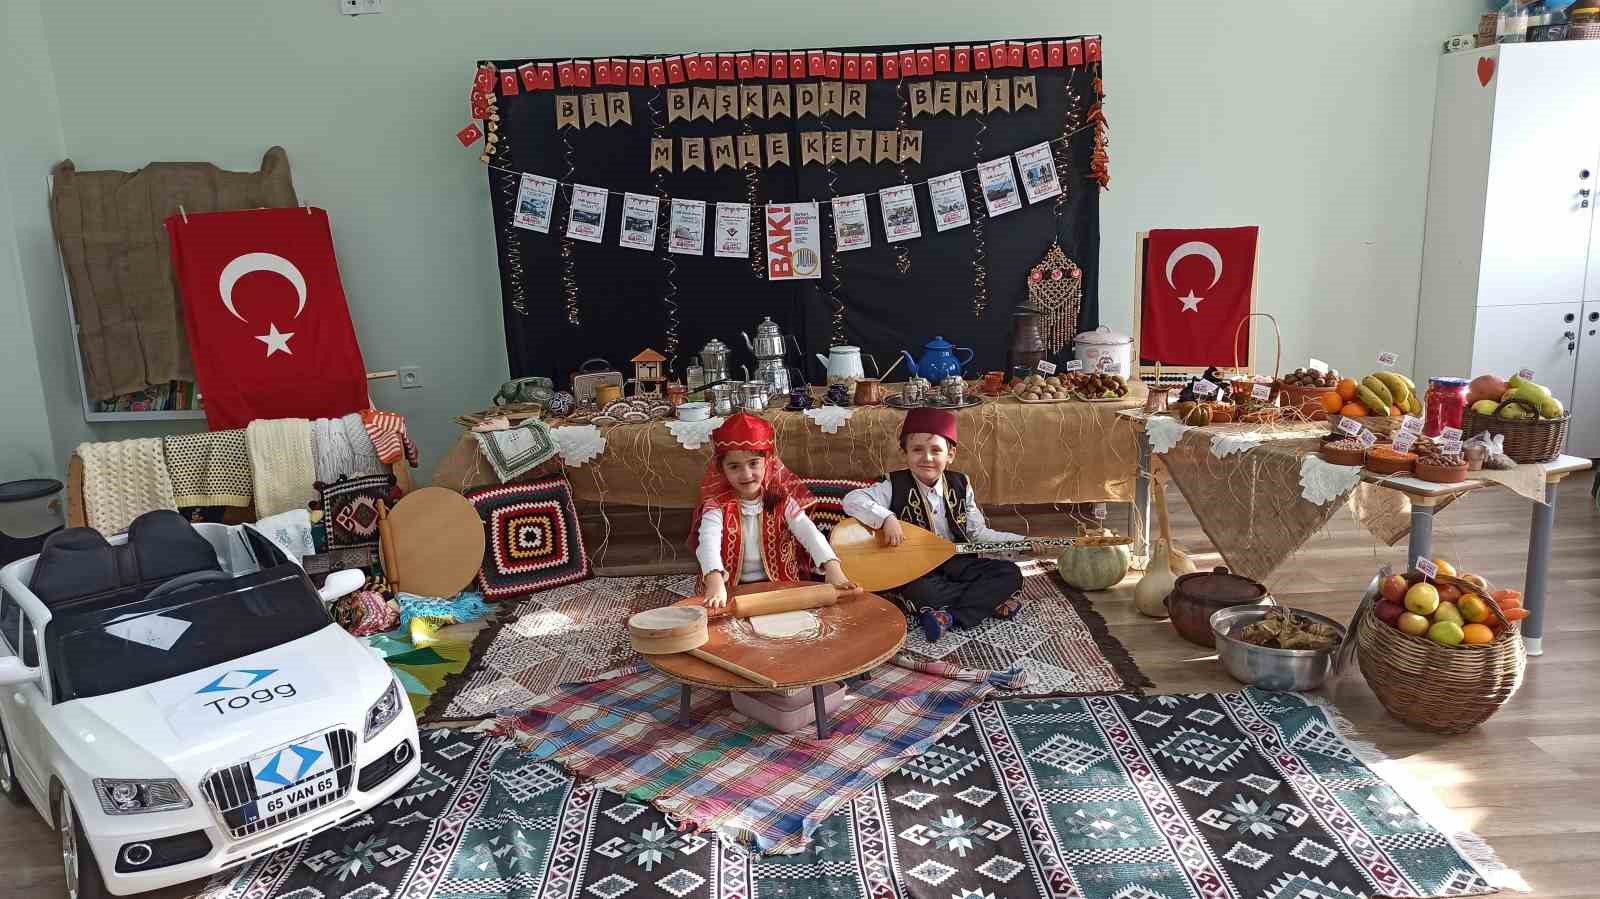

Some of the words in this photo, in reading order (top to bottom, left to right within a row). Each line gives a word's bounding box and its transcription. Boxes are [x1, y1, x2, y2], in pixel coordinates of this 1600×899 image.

[562, 98, 625, 118] BİR
[673, 90, 861, 112] BAŞKADIR
[915, 82, 1034, 105] BENİM
[203, 683, 297, 714] Togg
[267, 797, 284, 812] 65
[286, 784, 314, 804] VAN
[317, 777, 333, 792] 65
